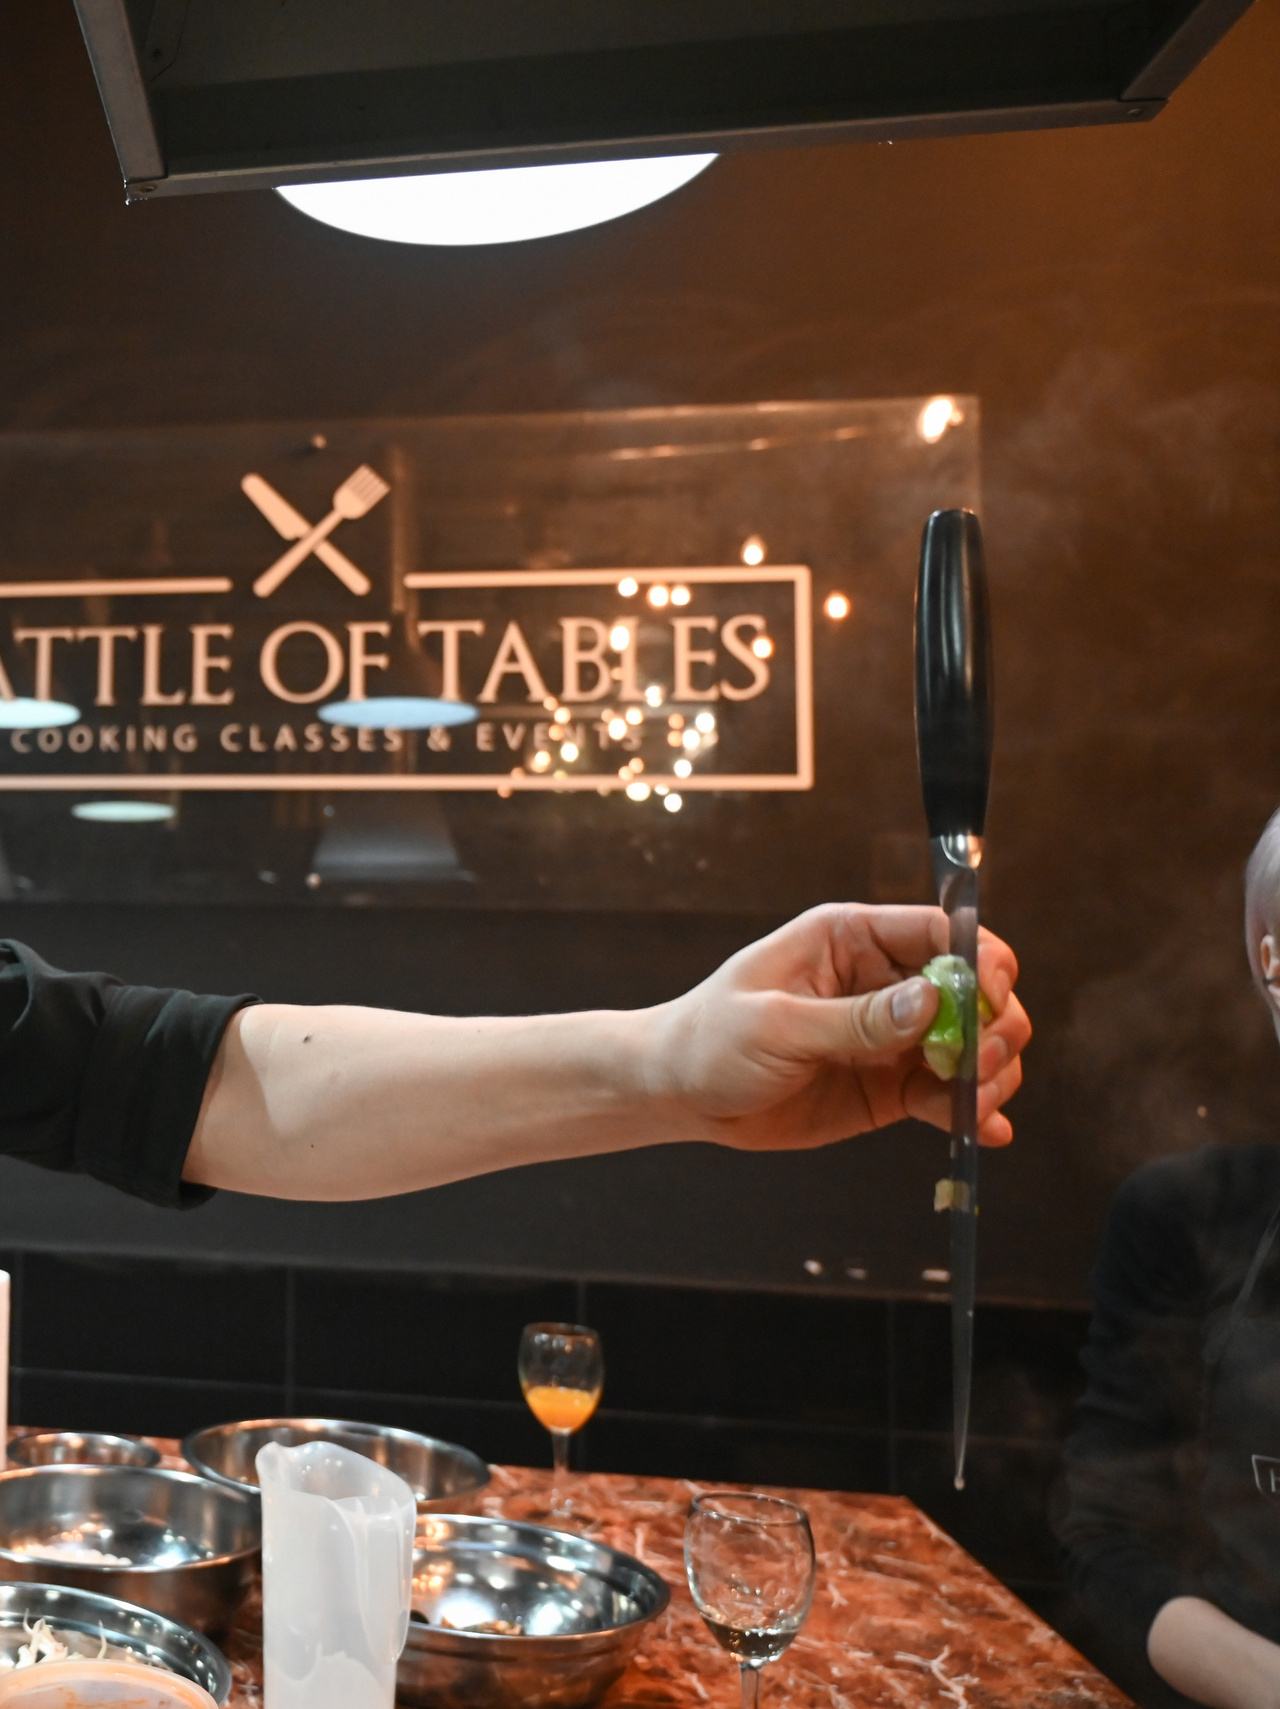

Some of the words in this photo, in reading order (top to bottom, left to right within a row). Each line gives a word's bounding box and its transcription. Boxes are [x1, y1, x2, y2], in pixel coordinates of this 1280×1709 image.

[259, 620, 391, 704] OF
[417, 614, 772, 702] TABLES
[10, 722, 199, 754] COOKING
[219, 722, 405, 753] CLASSES
[426, 724, 453, 752] &
